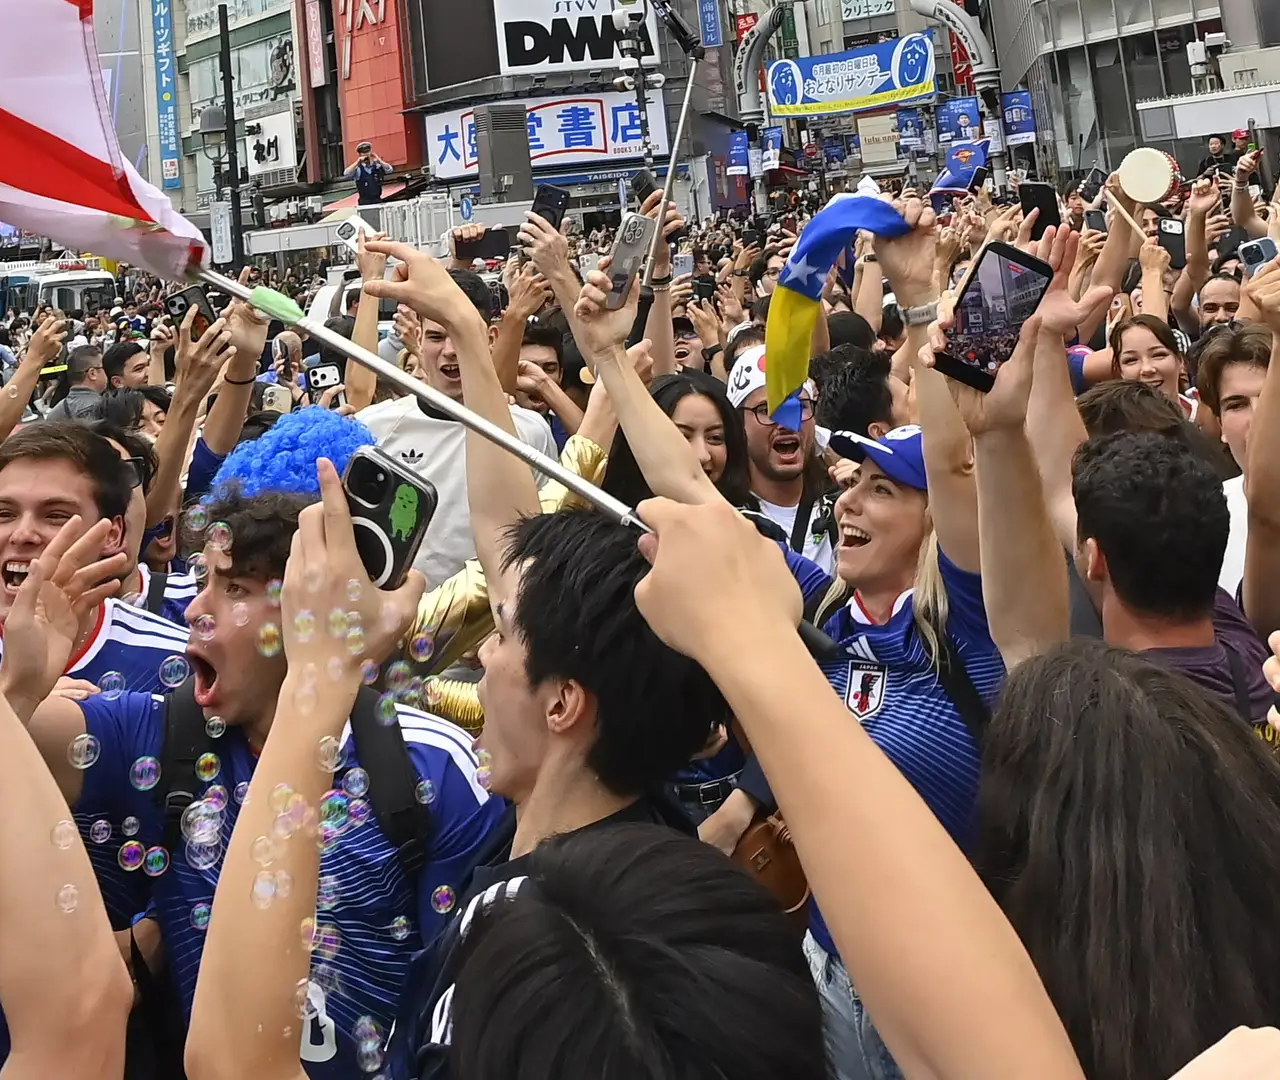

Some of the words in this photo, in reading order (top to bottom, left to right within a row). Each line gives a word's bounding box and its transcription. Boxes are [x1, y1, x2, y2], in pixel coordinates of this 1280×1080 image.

[554, 0, 598, 13] STVV
[844, 1, 893, 18] クリニック
[804, 71, 891, 96] おとなりサンデー
[587, 171, 630, 181] TAISEIDO
